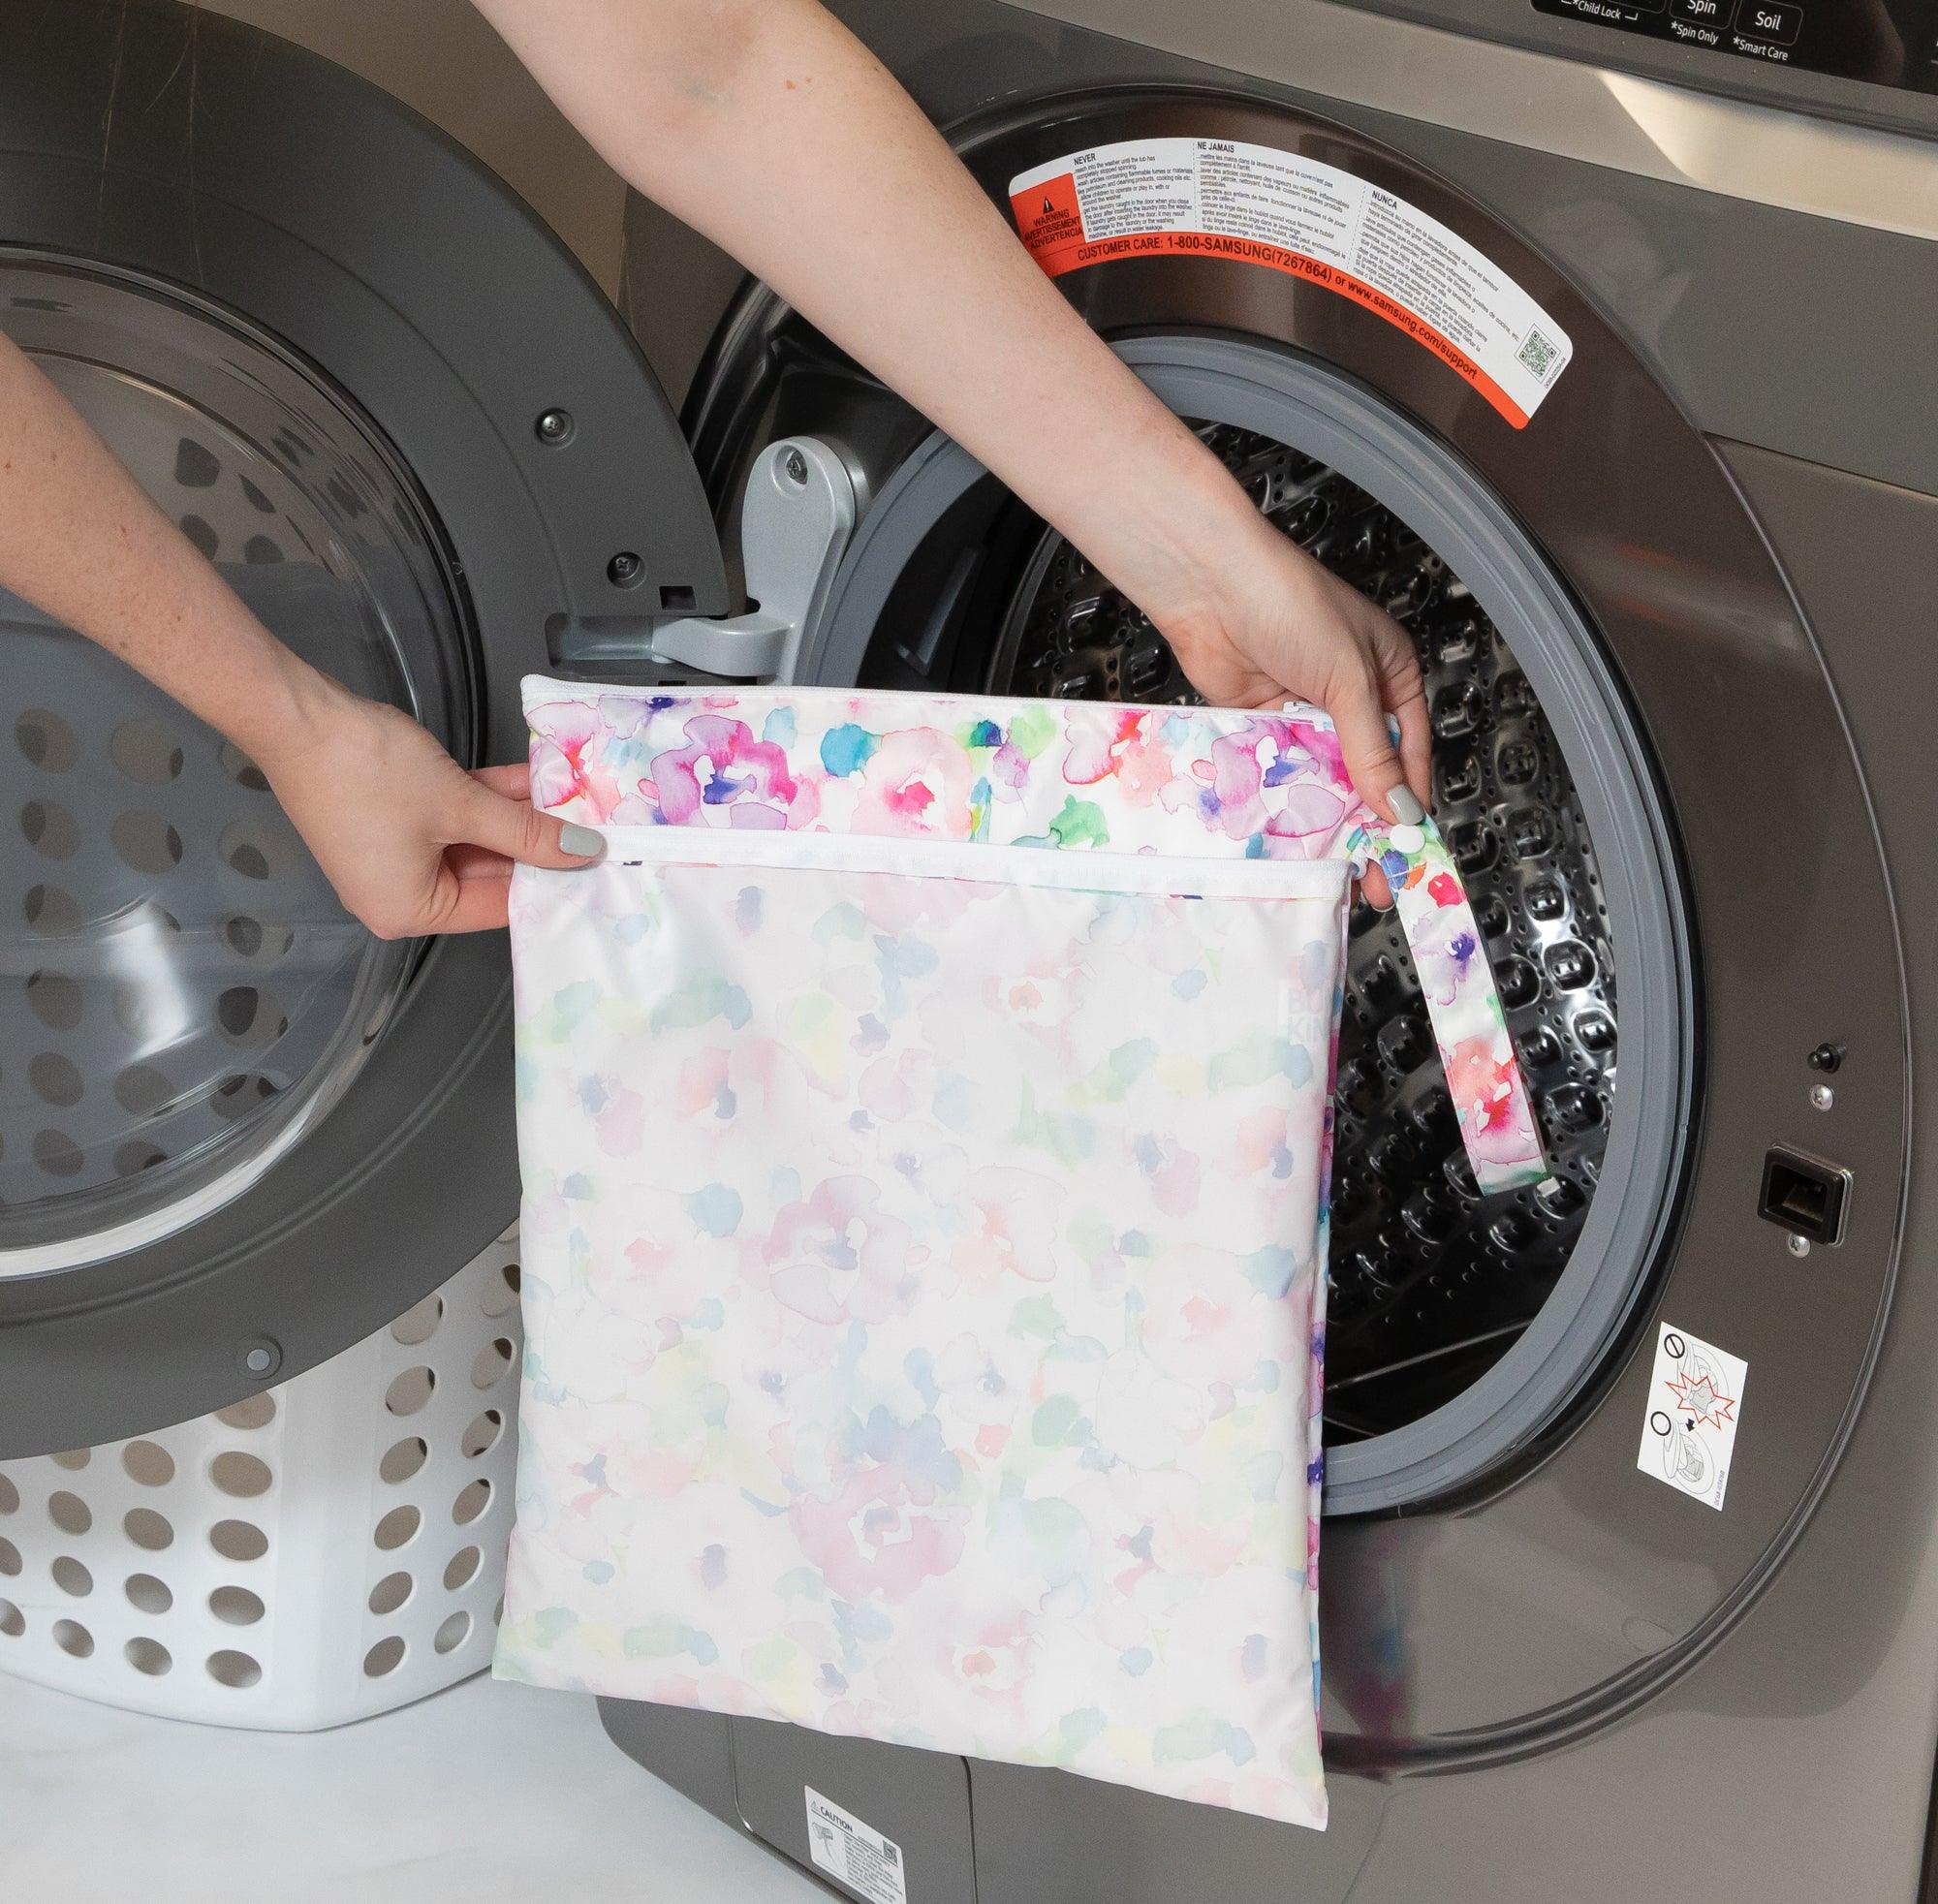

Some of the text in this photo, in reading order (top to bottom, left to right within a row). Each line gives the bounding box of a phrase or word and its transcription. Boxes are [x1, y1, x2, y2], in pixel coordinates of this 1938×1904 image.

[1601, 6, 1621, 19] Lock
[1687, 0, 1717, 14] Spin
[1755, 11, 1782, 30] Soil
[1698, 29, 1719, 45] Only
[1768, 47, 1788, 60] Care
[1208, 143, 1235, 153] JAMAIS
[1074, 153, 1096, 165] NEVER
[1372, 190, 1398, 210] NUNCA
[1033, 209, 1069, 226] WARNING
[1025, 216, 1080, 240] AVERTISSEMENT
[1031, 228, 1082, 250] ADVERTENCIA
[1078, 236, 1477, 379] CUSTOMER CARE: 1-800-SAMSUNG(7267864) or www.samsung.com/support
[820, 1806, 853, 1833] CAUTION
